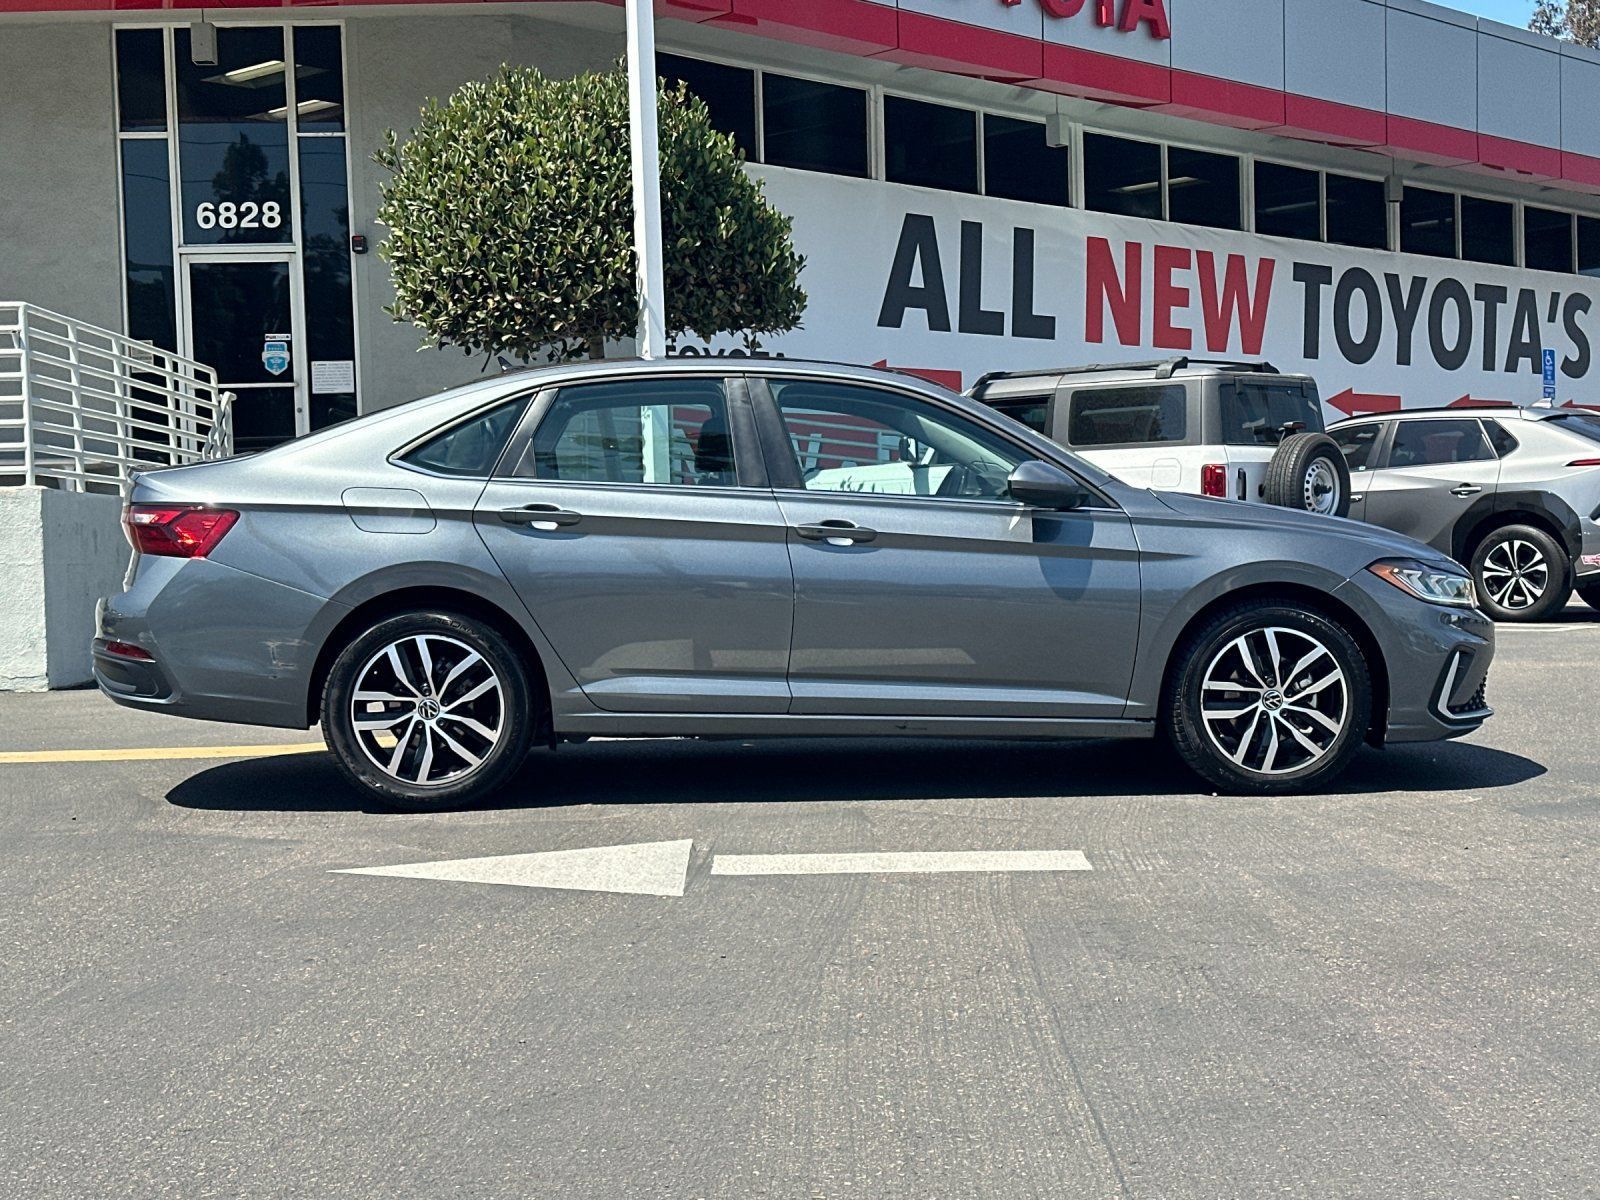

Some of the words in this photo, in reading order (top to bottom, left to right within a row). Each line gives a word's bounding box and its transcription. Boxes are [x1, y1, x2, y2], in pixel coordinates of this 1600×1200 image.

[196, 201, 282, 229] 6828
[877, 213, 1056, 340] ALL
[1085, 236, 1276, 355] NEW
[1292, 261, 1593, 379] TOYOTA'S
